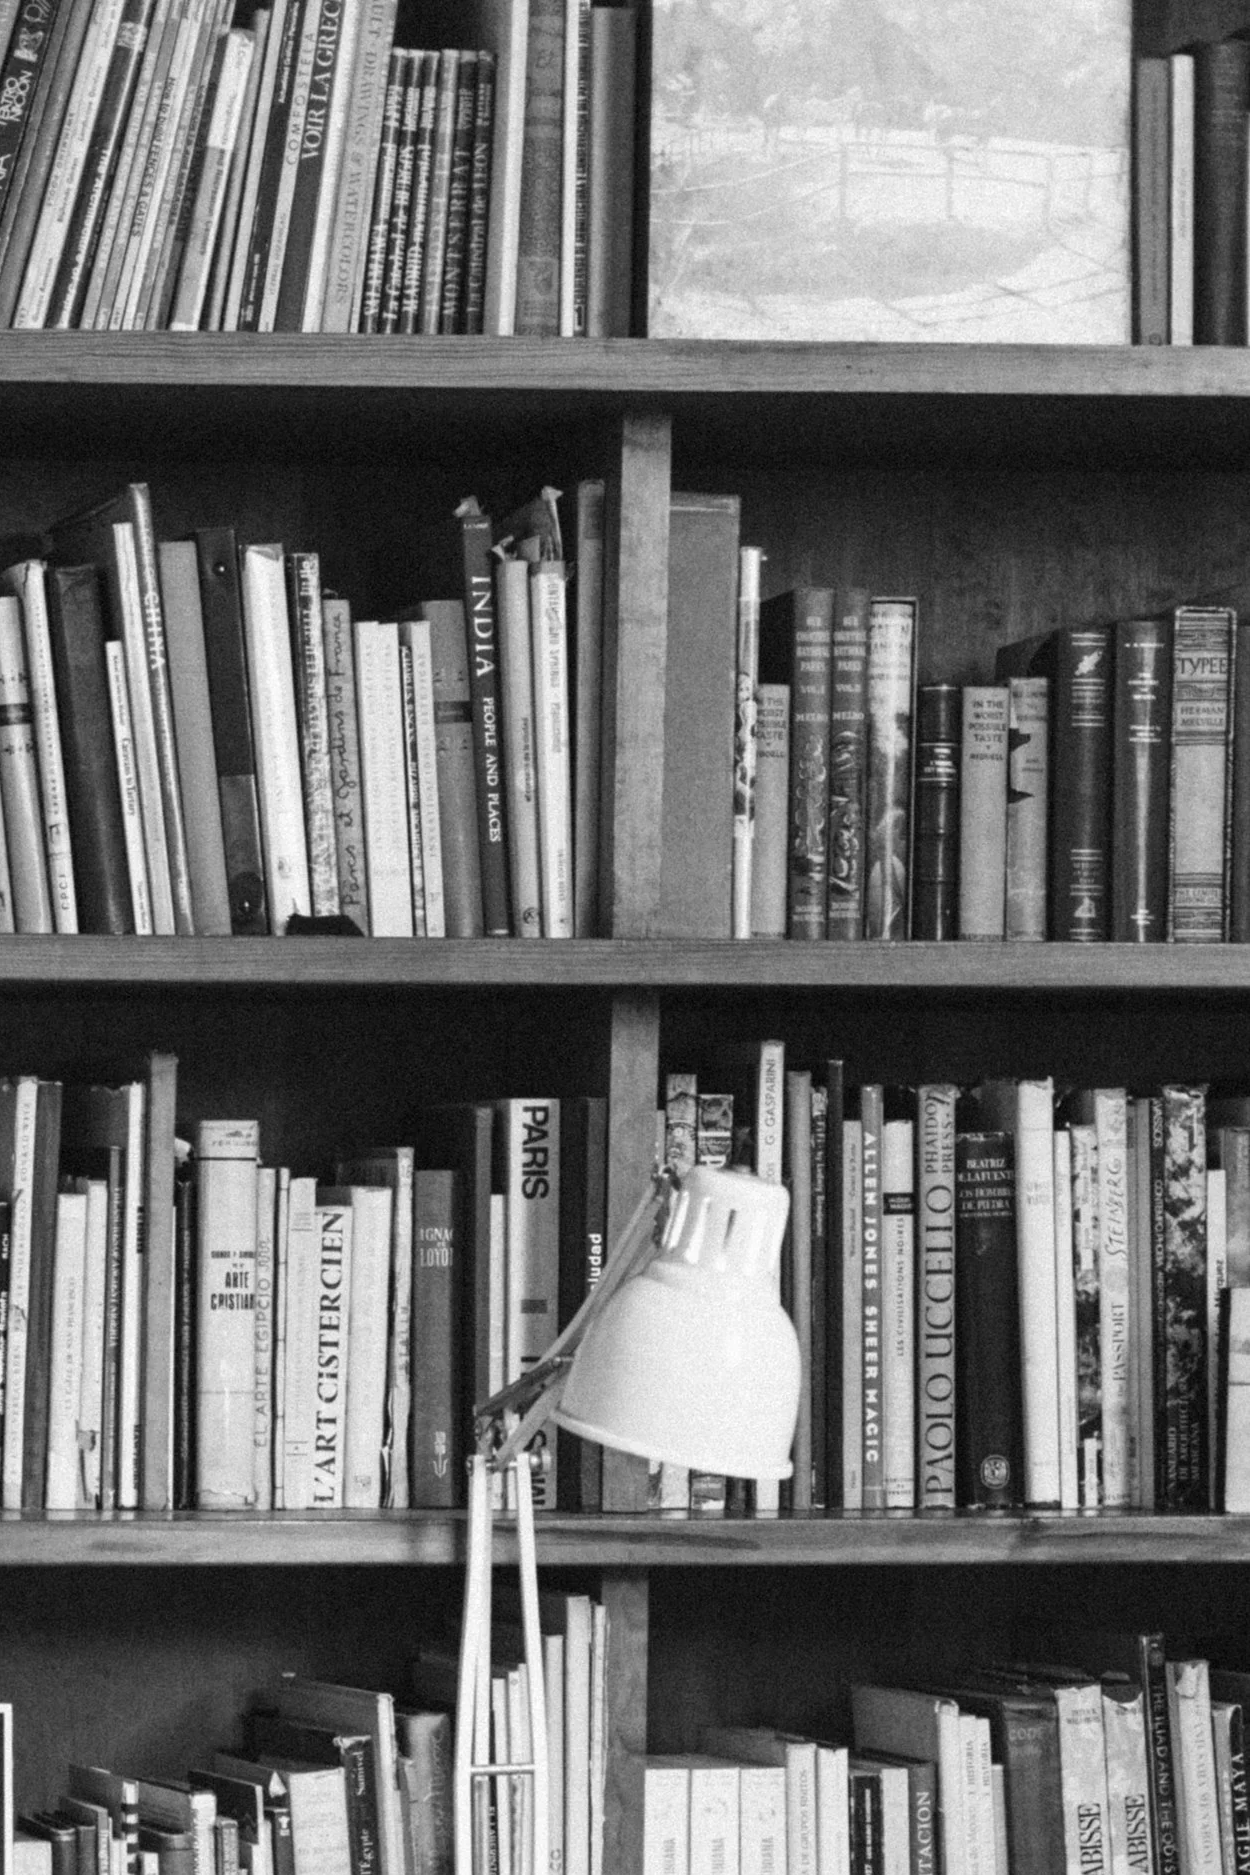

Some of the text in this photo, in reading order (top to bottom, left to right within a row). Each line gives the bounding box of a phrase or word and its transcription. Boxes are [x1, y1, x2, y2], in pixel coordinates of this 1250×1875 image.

[284, 30, 314, 166] COMPOSTELA
[300, 69, 332, 162] VOIR LA
[130, 198, 148, 238] GATES
[331, 49, 378, 304] DRAWINGS WATERCOLORS
[441, 146, 469, 316] MONTSERRAT
[139, 590, 169, 670] CHINA
[463, 573, 504, 677] INDIA
[1179, 656, 1226, 675] TYPEE
[973, 733, 1004, 743] TASTE
[985, 700, 1004, 709] THE
[1180, 705, 1225, 715] HERMAN
[1181, 717, 1224, 727] MELVILLE
[328, 609, 361, 906] Parcs et de France
[481, 695, 503, 844] PEOPLE AND PLACES
[763, 1057, 777, 1127] GASPARINI
[521, 1105, 549, 1200] PARIS
[966, 1158, 1006, 1169] BEATRIZ
[1102, 1158, 1130, 1255] STEINBERG
[225, 1272, 250, 1289] ARTE
[862, 1131, 880, 1463] ALLEN JONES SHEER MAGIC
[896, 1217, 904, 1357] LES CIVILISATIONS NOIRES
[253, 1277, 271, 1447] EL ARTE EGIPCIO
[923, 1183, 955, 1495] PAOLO UCCELLO
[1110, 1302, 1126, 1381] PASSPORT
[311, 1410, 339, 1502] L'ART
[350, 1750, 367, 1796] Samivel
[1153, 1714, 1174, 1828] ILIAD AND THE
[1230, 1750, 1248, 1812] MAYA
